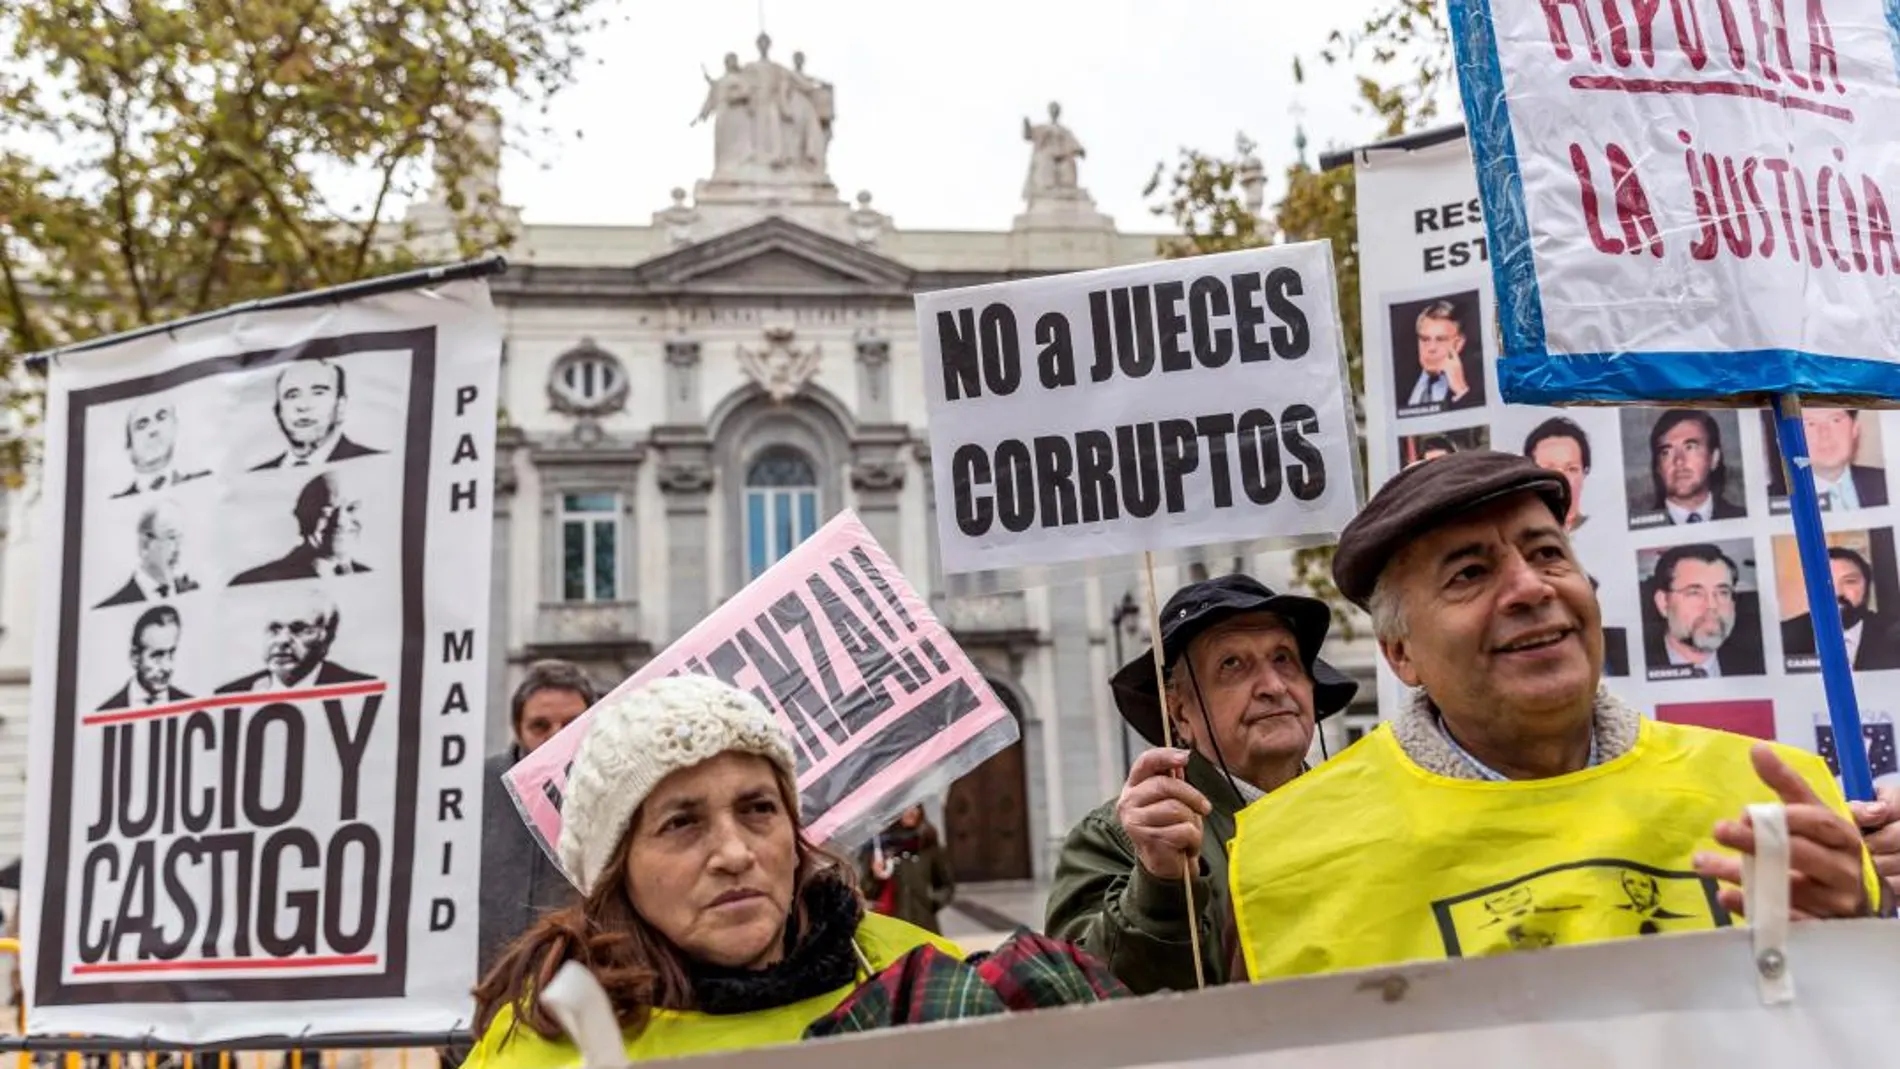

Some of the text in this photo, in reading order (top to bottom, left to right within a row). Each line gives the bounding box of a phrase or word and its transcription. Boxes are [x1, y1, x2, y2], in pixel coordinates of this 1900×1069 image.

[1569, 129, 1900, 275] LA JUSTICIA
[937, 266, 1310, 401] NO a JUECES
[449, 384, 479, 513] PAH
[951, 403, 1327, 537] CORRUPTOS
[86, 693, 384, 842] JUICIO Y
[429, 629, 475, 933] MADRID
[78, 822, 382, 964] CASTIGO
